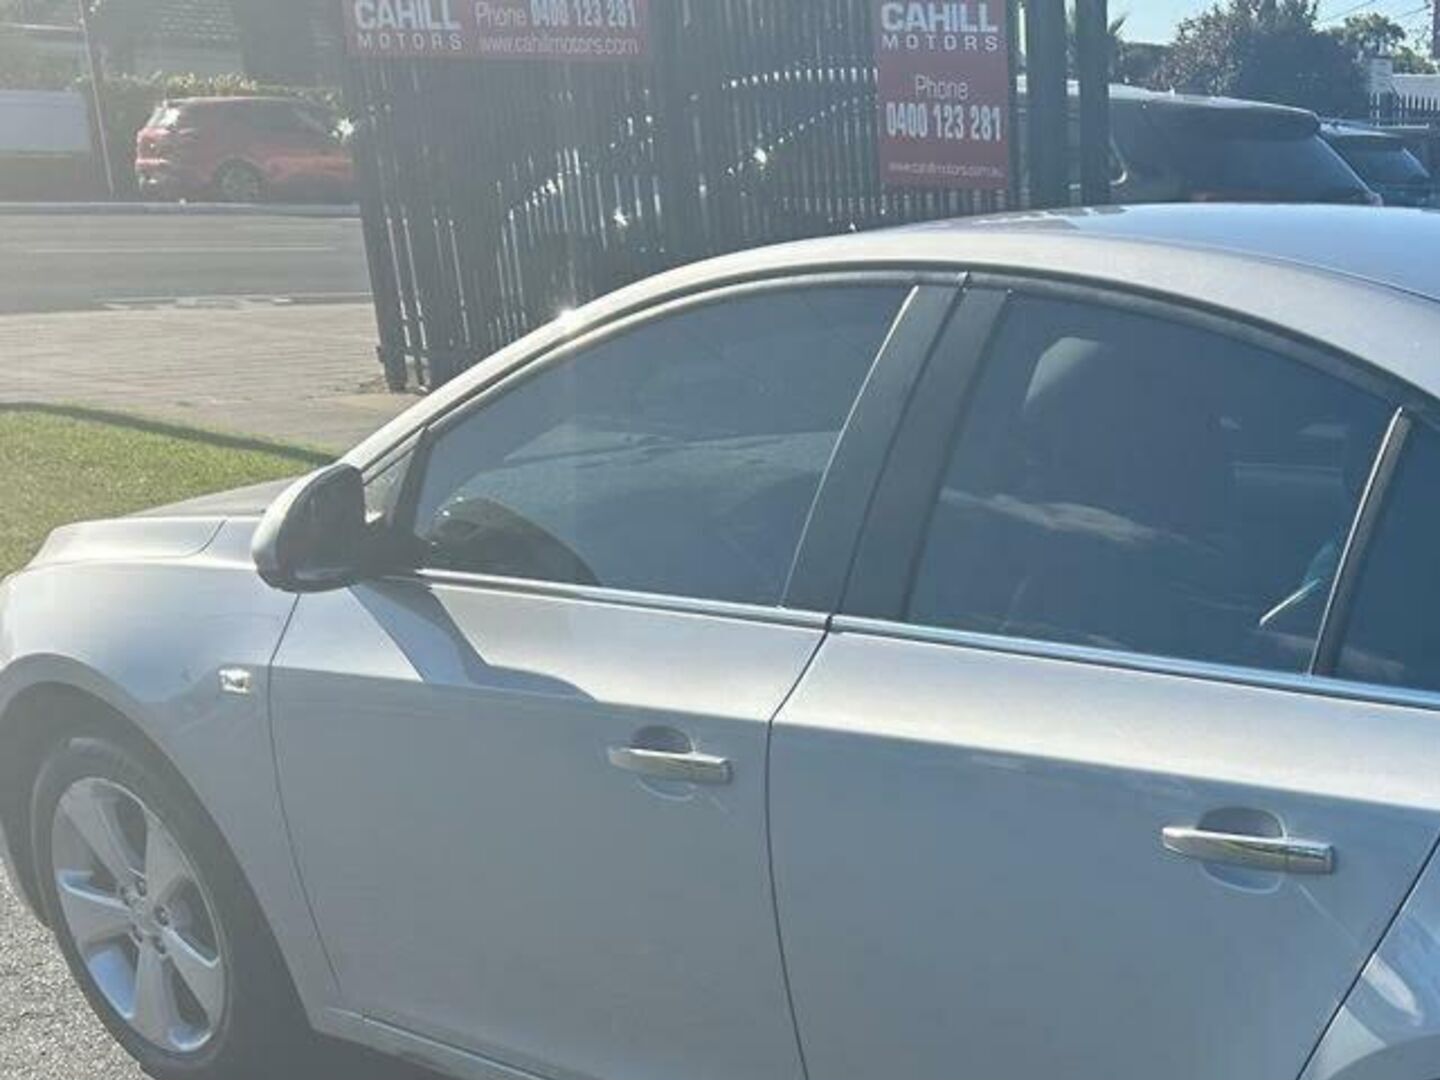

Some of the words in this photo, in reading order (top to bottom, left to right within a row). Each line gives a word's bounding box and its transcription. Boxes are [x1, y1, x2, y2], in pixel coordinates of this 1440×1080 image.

[354, 0, 462, 30] CAHILL
[474, 1, 528, 29] Phone
[530, 0, 570, 27] 0400
[573, 0, 602, 27] 123
[606, 0, 637, 28] 281
[881, 3, 999, 33] CAHILL
[357, 32, 463, 51] MOTORS
[881, 33, 999, 51] MOTORS
[915, 74, 969, 101] Phone
[885, 101, 929, 139] 0400
[932, 104, 965, 140] 123
[969, 105, 1001, 142] 281
